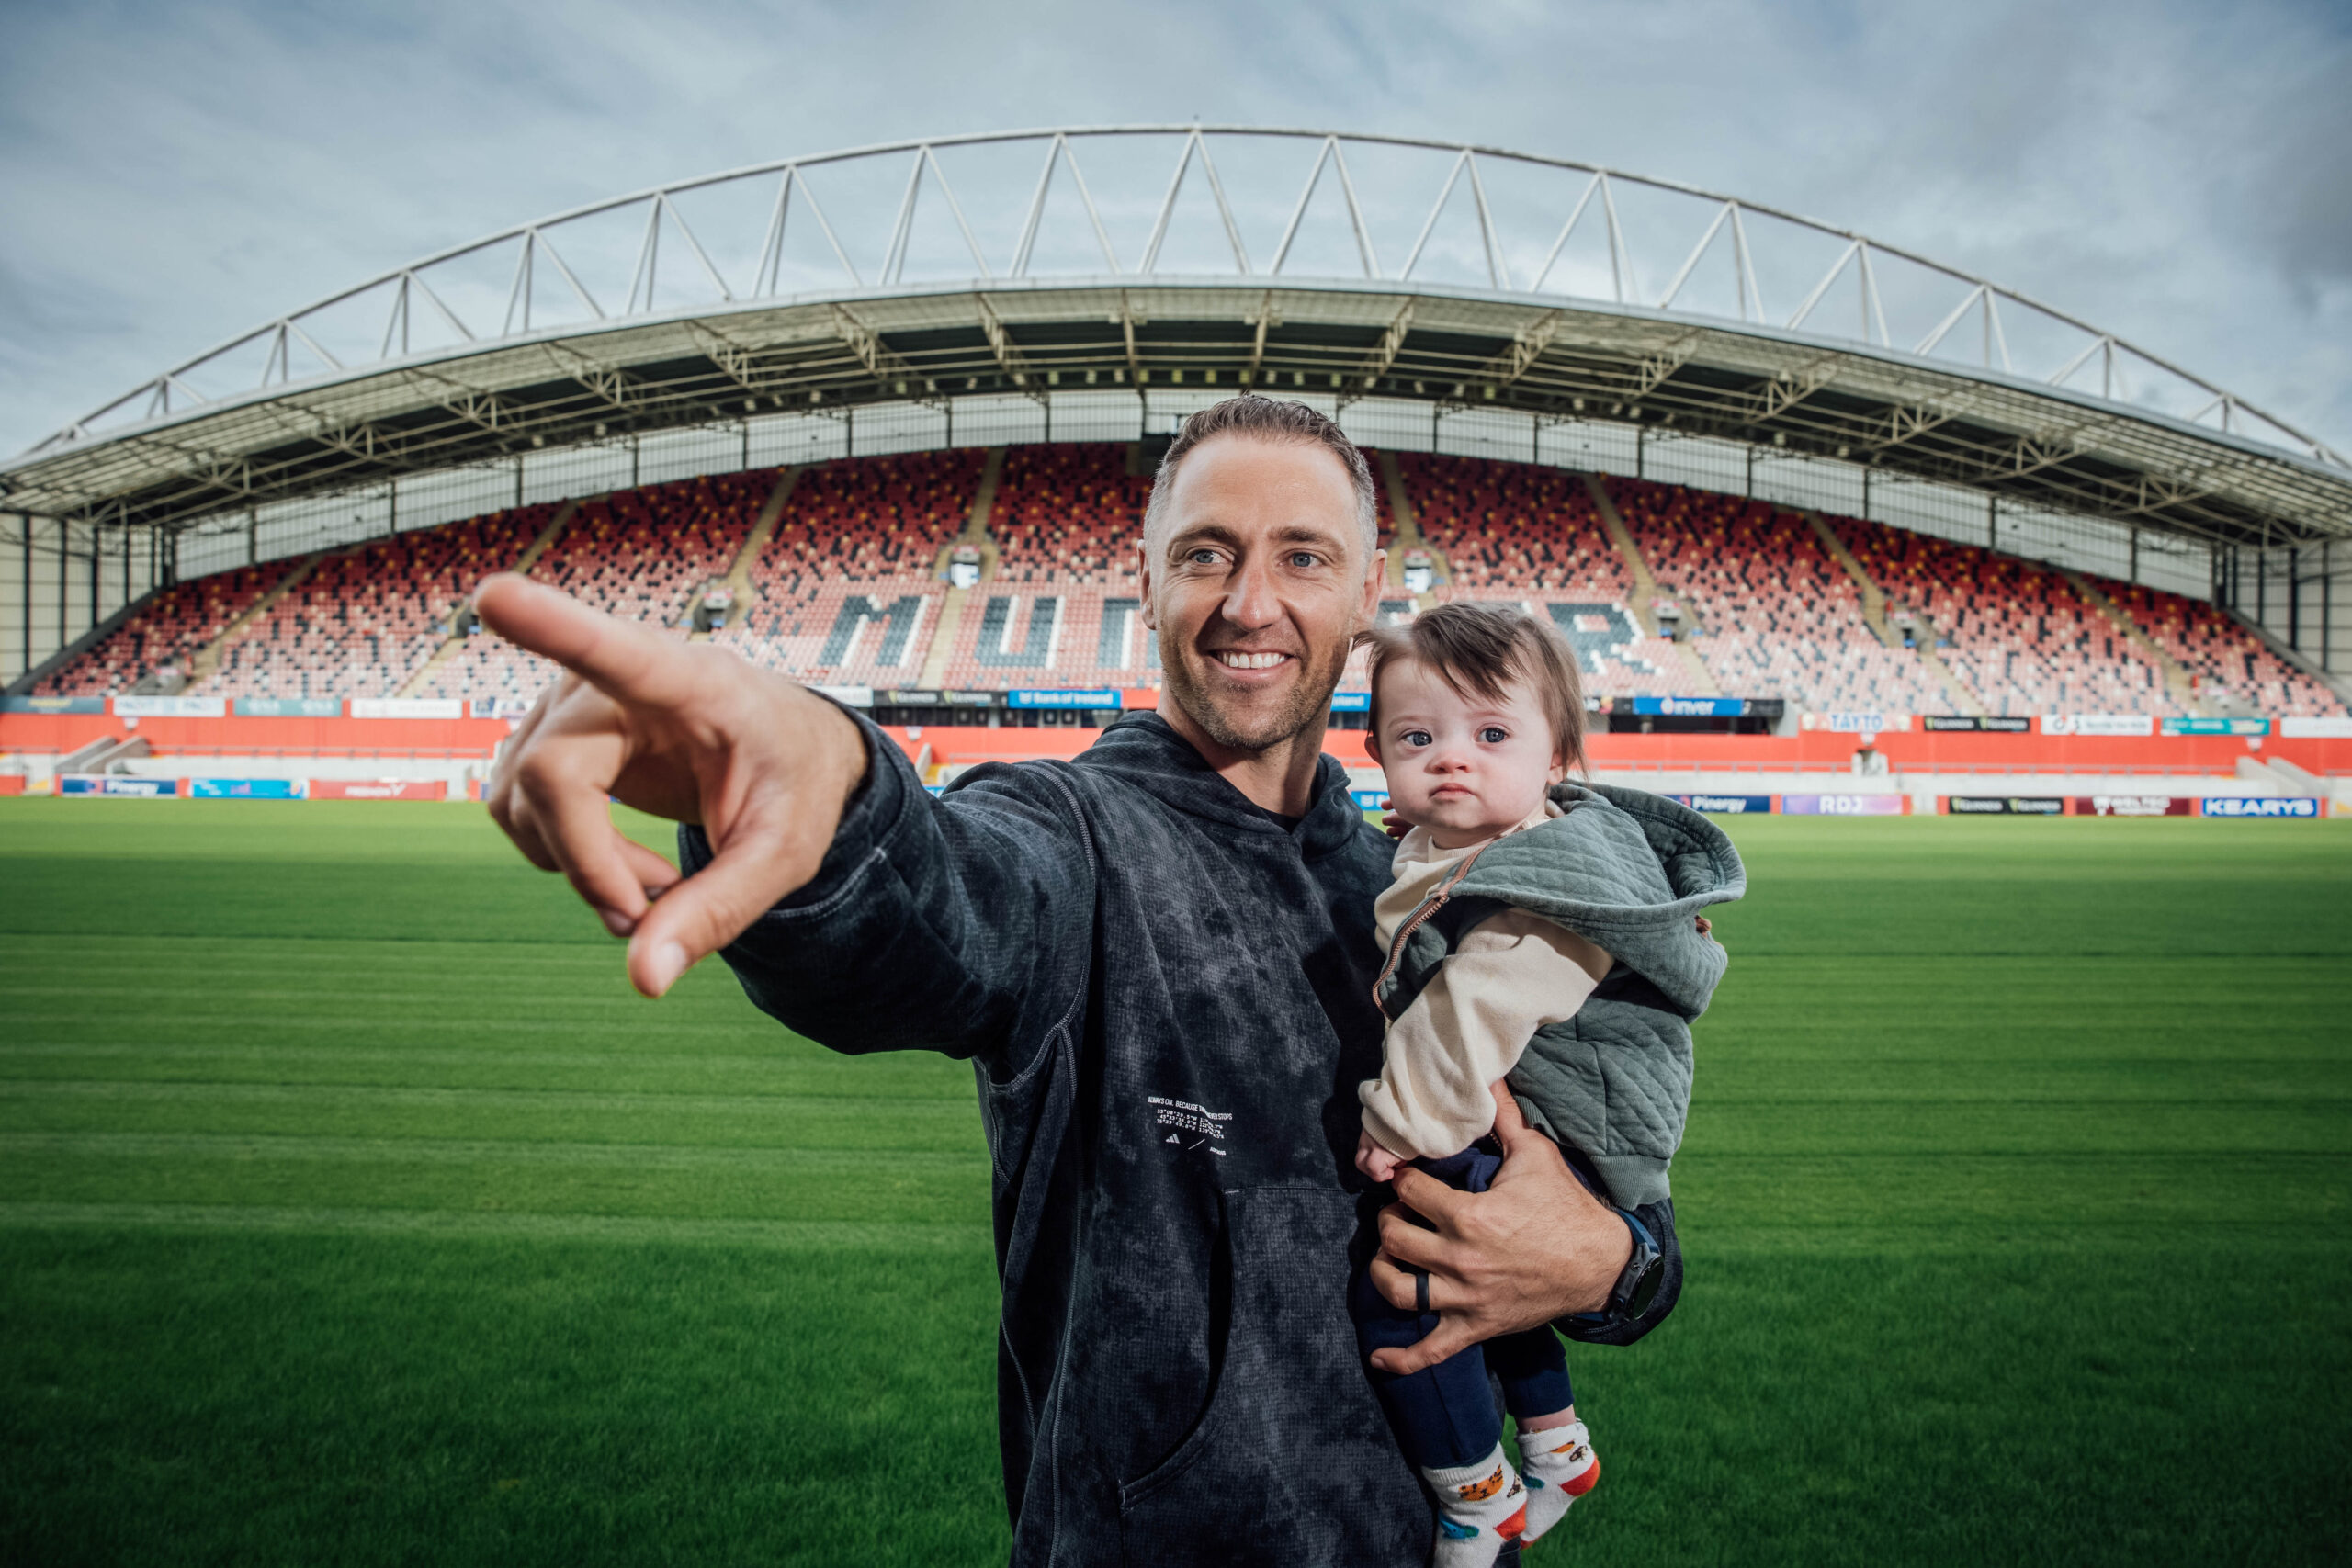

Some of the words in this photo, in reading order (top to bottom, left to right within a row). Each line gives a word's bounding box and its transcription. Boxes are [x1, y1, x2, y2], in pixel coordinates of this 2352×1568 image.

[1033, 692, 1058, 705] Bank
[1061, 692, 1073, 705] of
[1074, 693, 1114, 705] Ireland
[1830, 714, 1883, 731] TAYTO
[106, 779, 159, 796] Pinergy
[1692, 796, 1747, 813] Pinergy
[1819, 795, 1864, 814] RDJ
[2205, 798, 2314, 816] KEARYS
[1148, 1096, 1165, 1105] ALWAYS
[1175, 1100, 1199, 1111] BECAUSE
